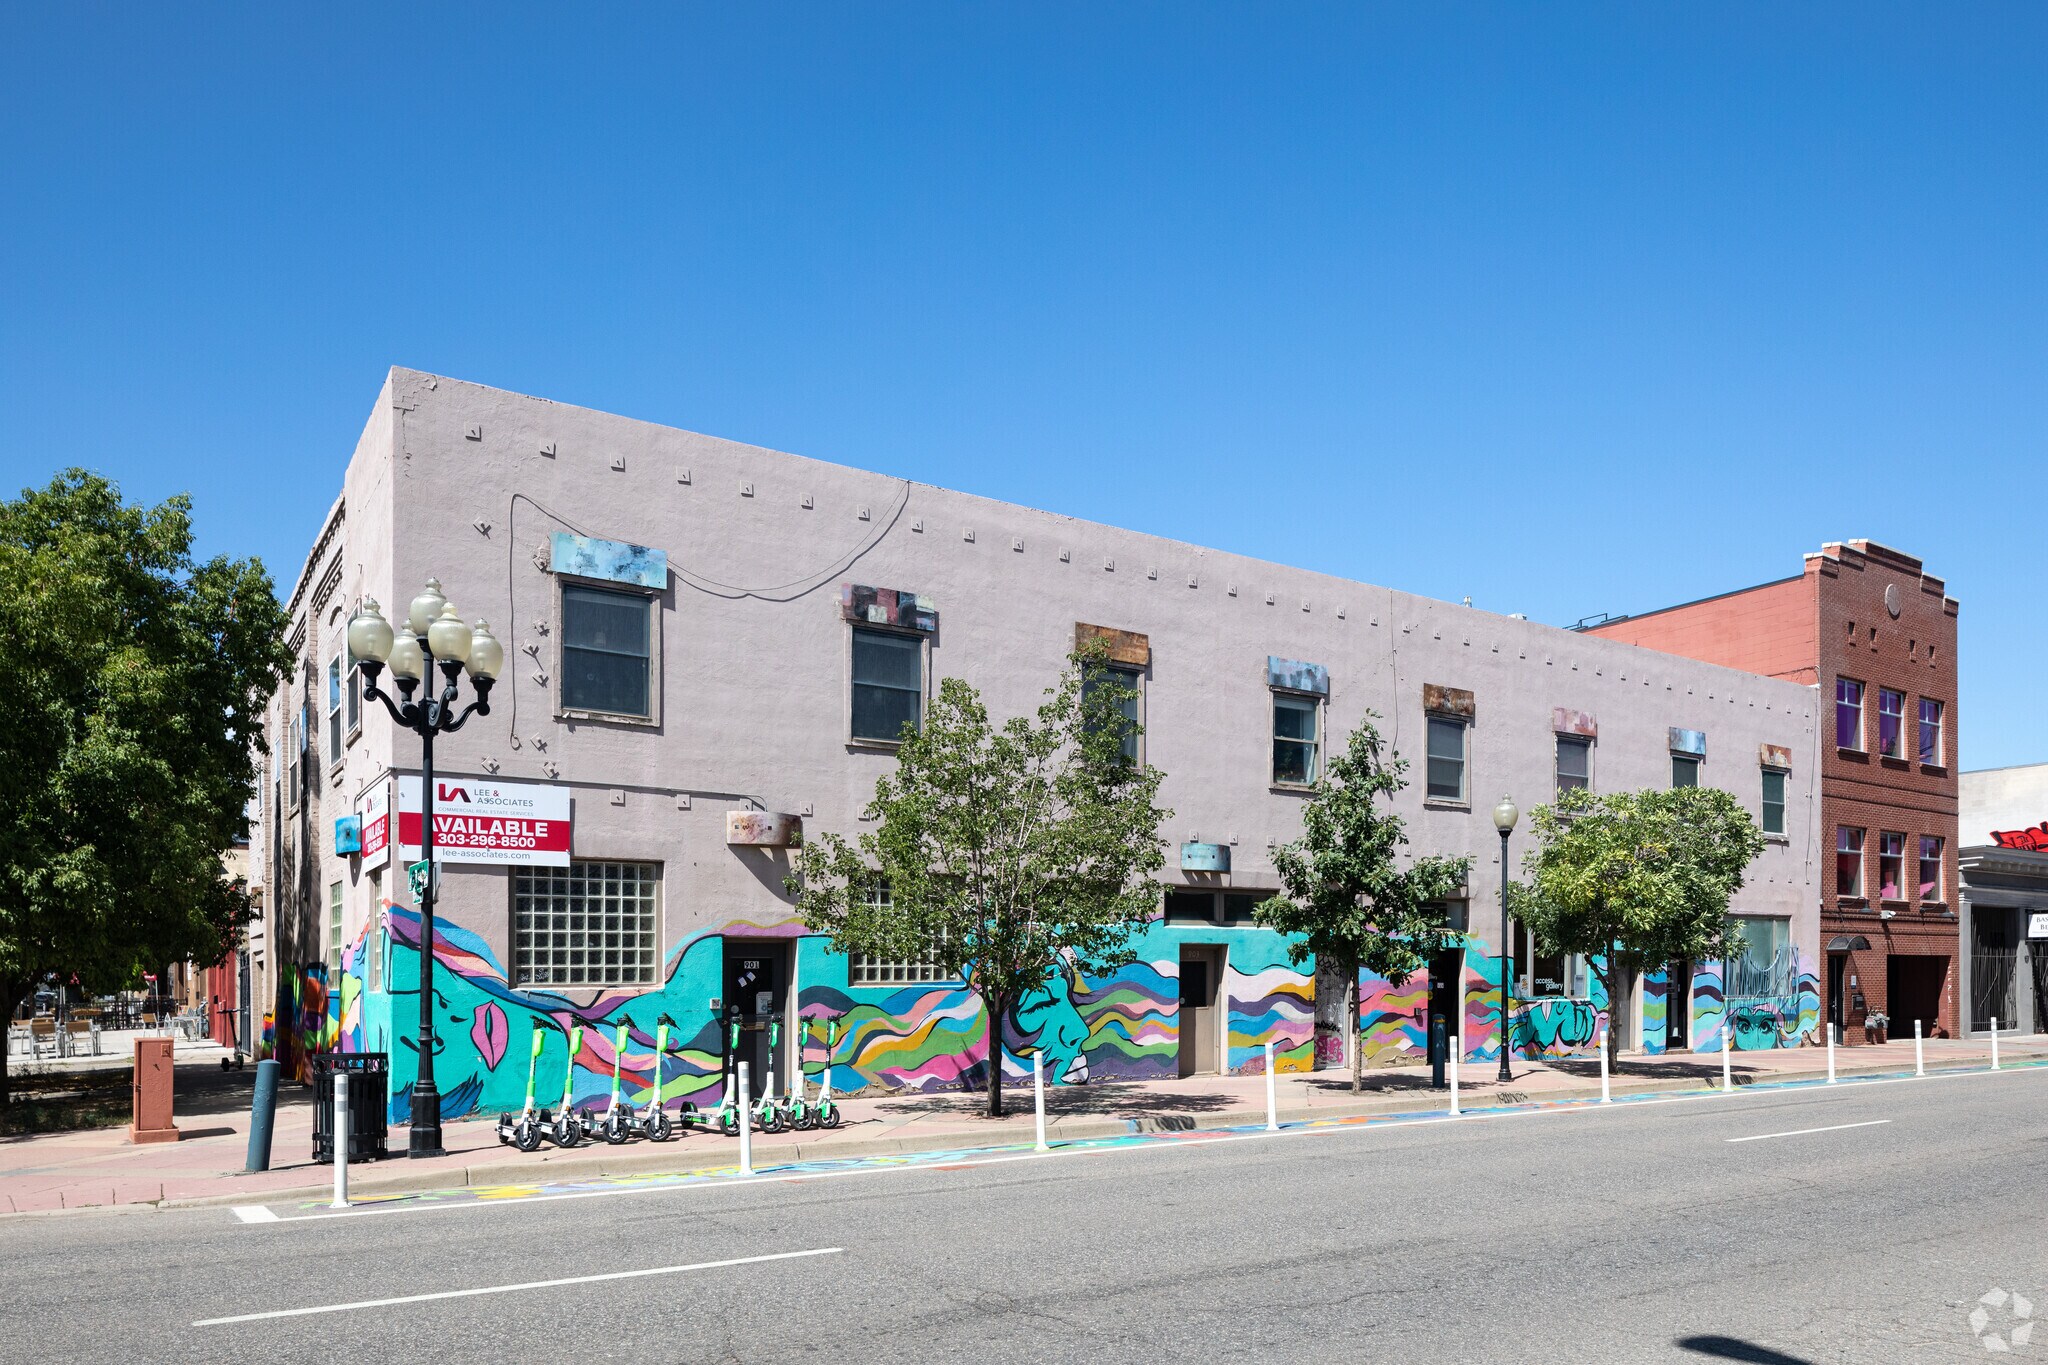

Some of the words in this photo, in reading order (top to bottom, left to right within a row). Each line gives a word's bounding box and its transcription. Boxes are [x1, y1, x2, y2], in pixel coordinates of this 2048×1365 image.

[474, 788, 490, 797] LEE
[492, 789, 500, 797] &
[477, 797, 534, 807] ASSOCIATES
[438, 806, 474, 814] COMMERCIAL
[437, 833, 536, 848] 303-296-8500
[442, 848, 531, 860] lee-associates.com
[744, 961, 759, 969] 901
[1546, 982, 1563, 991] gallery
